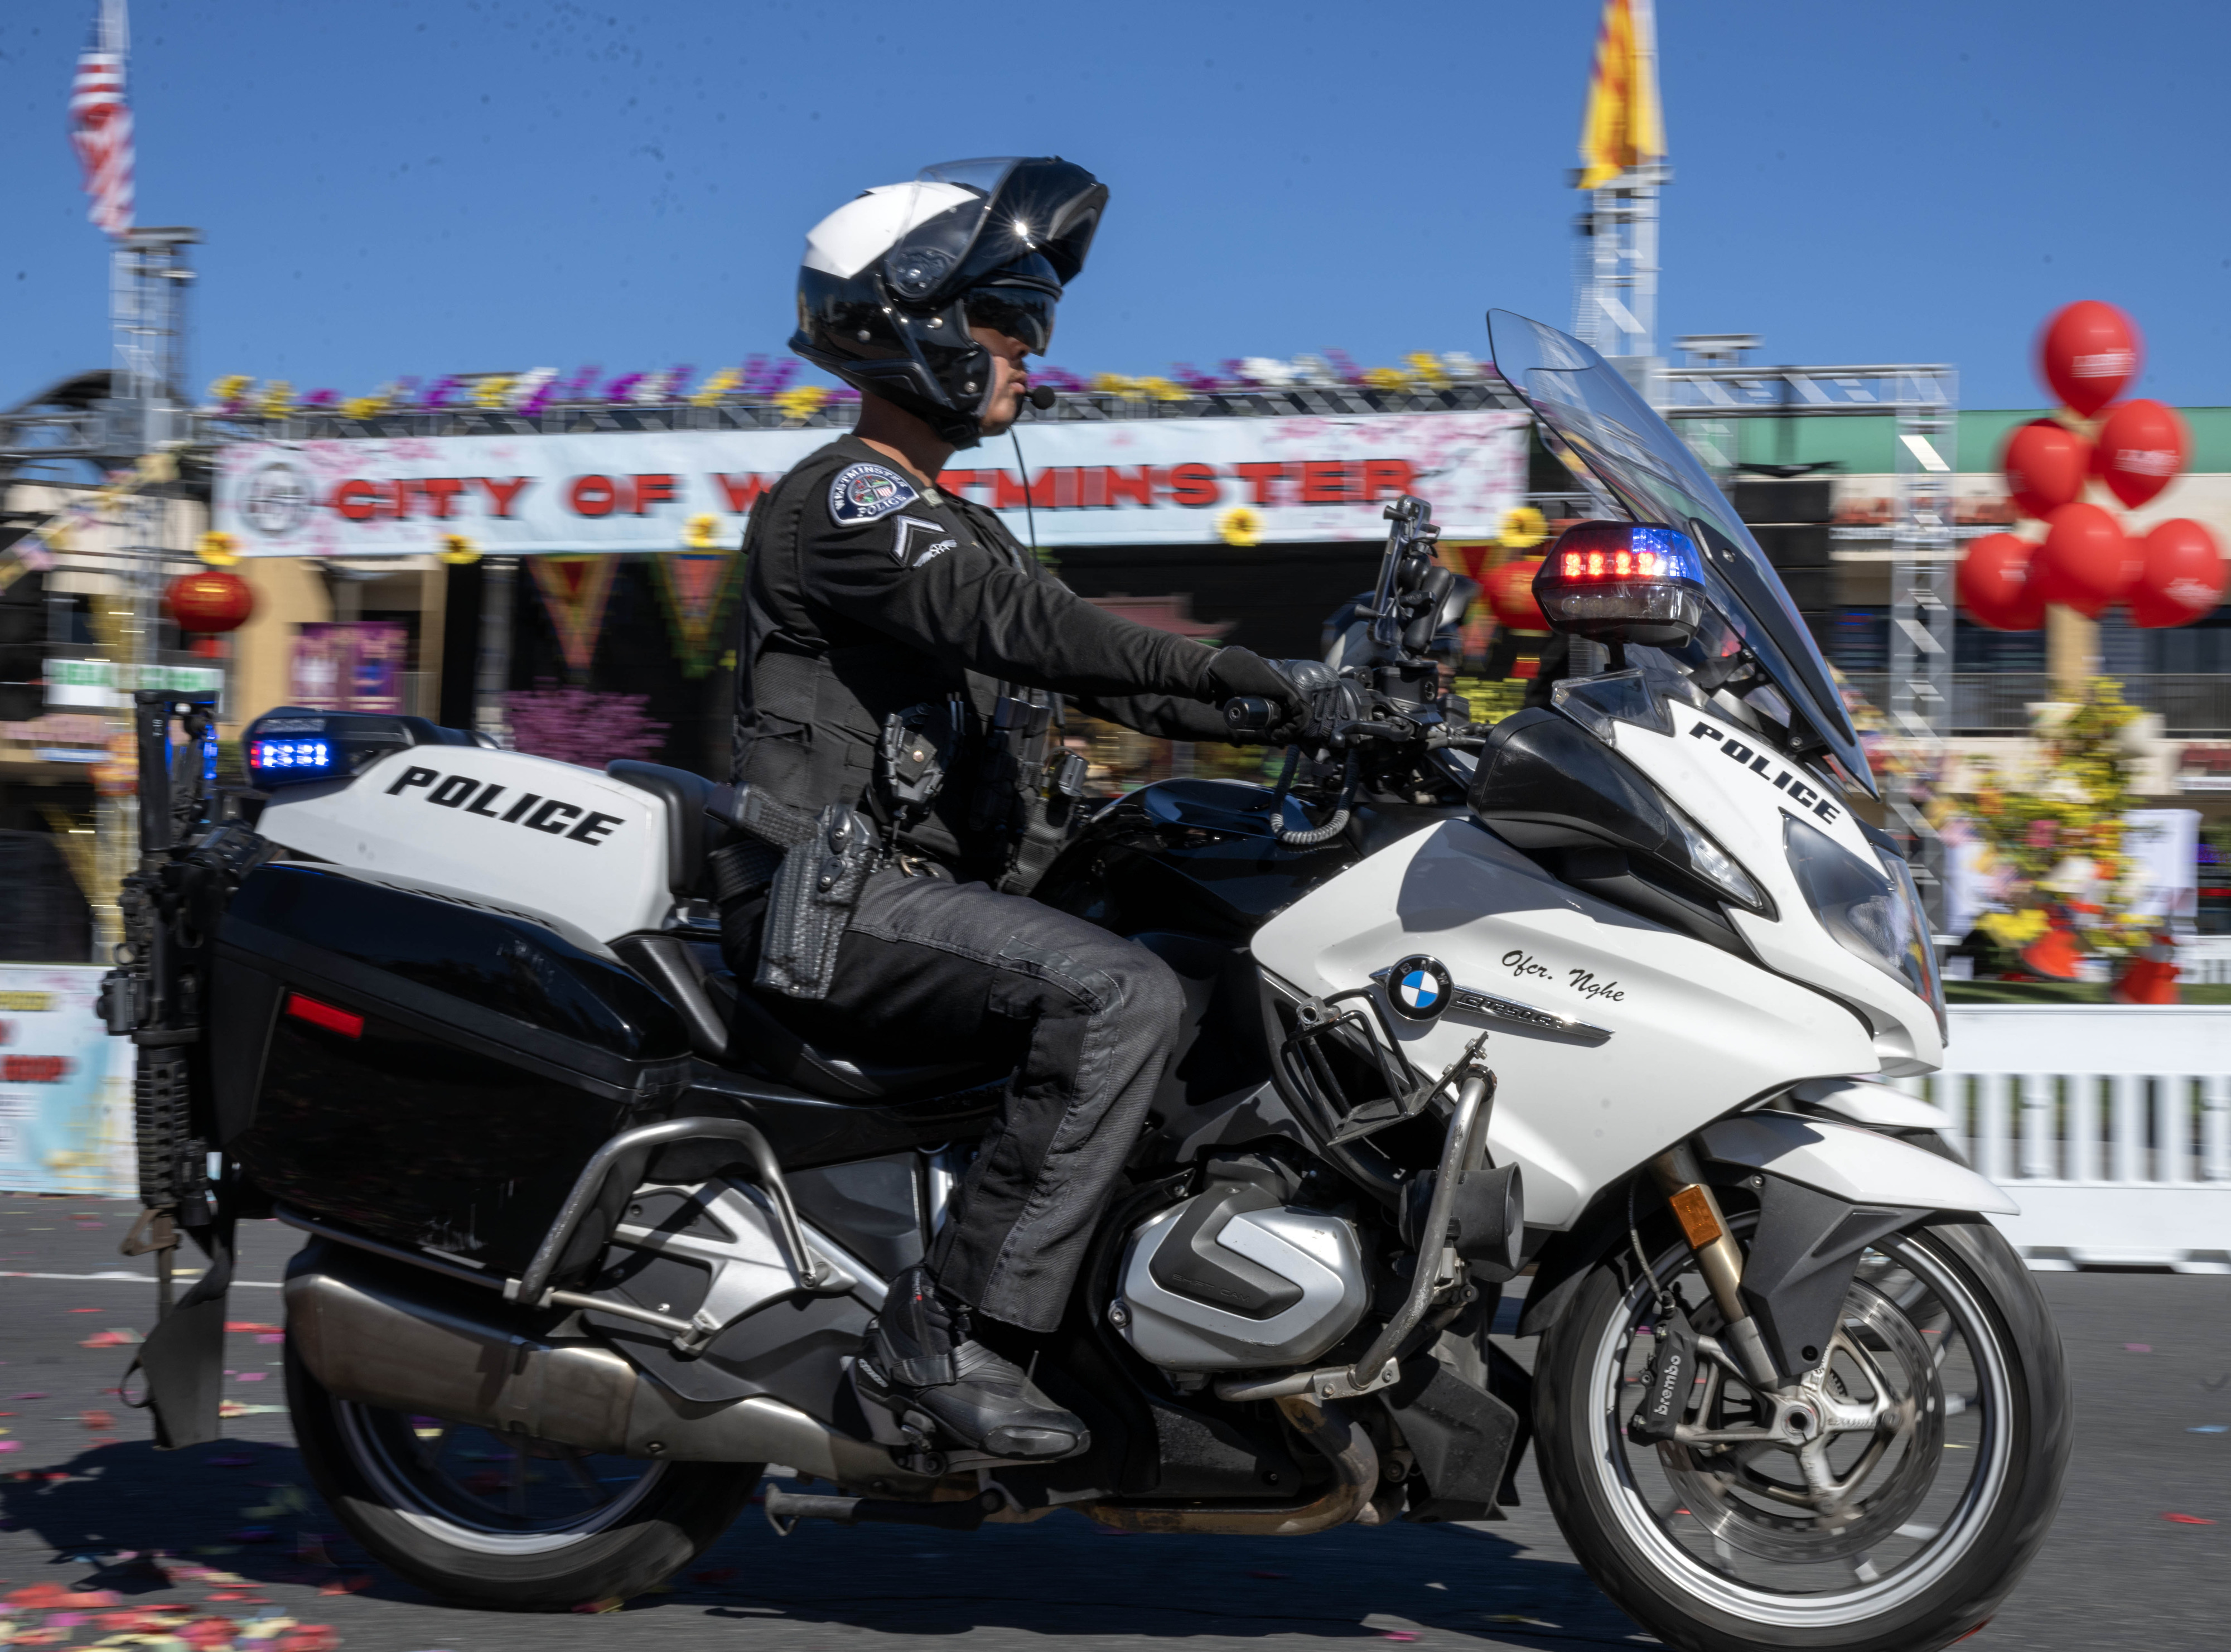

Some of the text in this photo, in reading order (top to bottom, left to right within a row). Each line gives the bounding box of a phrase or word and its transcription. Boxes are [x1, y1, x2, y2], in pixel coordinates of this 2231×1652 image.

[334, 458, 1417, 522] CITY OF WTMINSTER
[834, 466, 908, 511] WESTMINSTER
[856, 495, 907, 518] POLICE
[1689, 721, 1841, 825] POLICE
[384, 765, 626, 846] POLICE
[1399, 959, 1449, 986] BMW
[1502, 950, 1625, 1002] Ofcr. Nghe
[1172, 1273, 1250, 1302] SHIFT CAM
[1653, 1355, 1681, 1416] brembo
